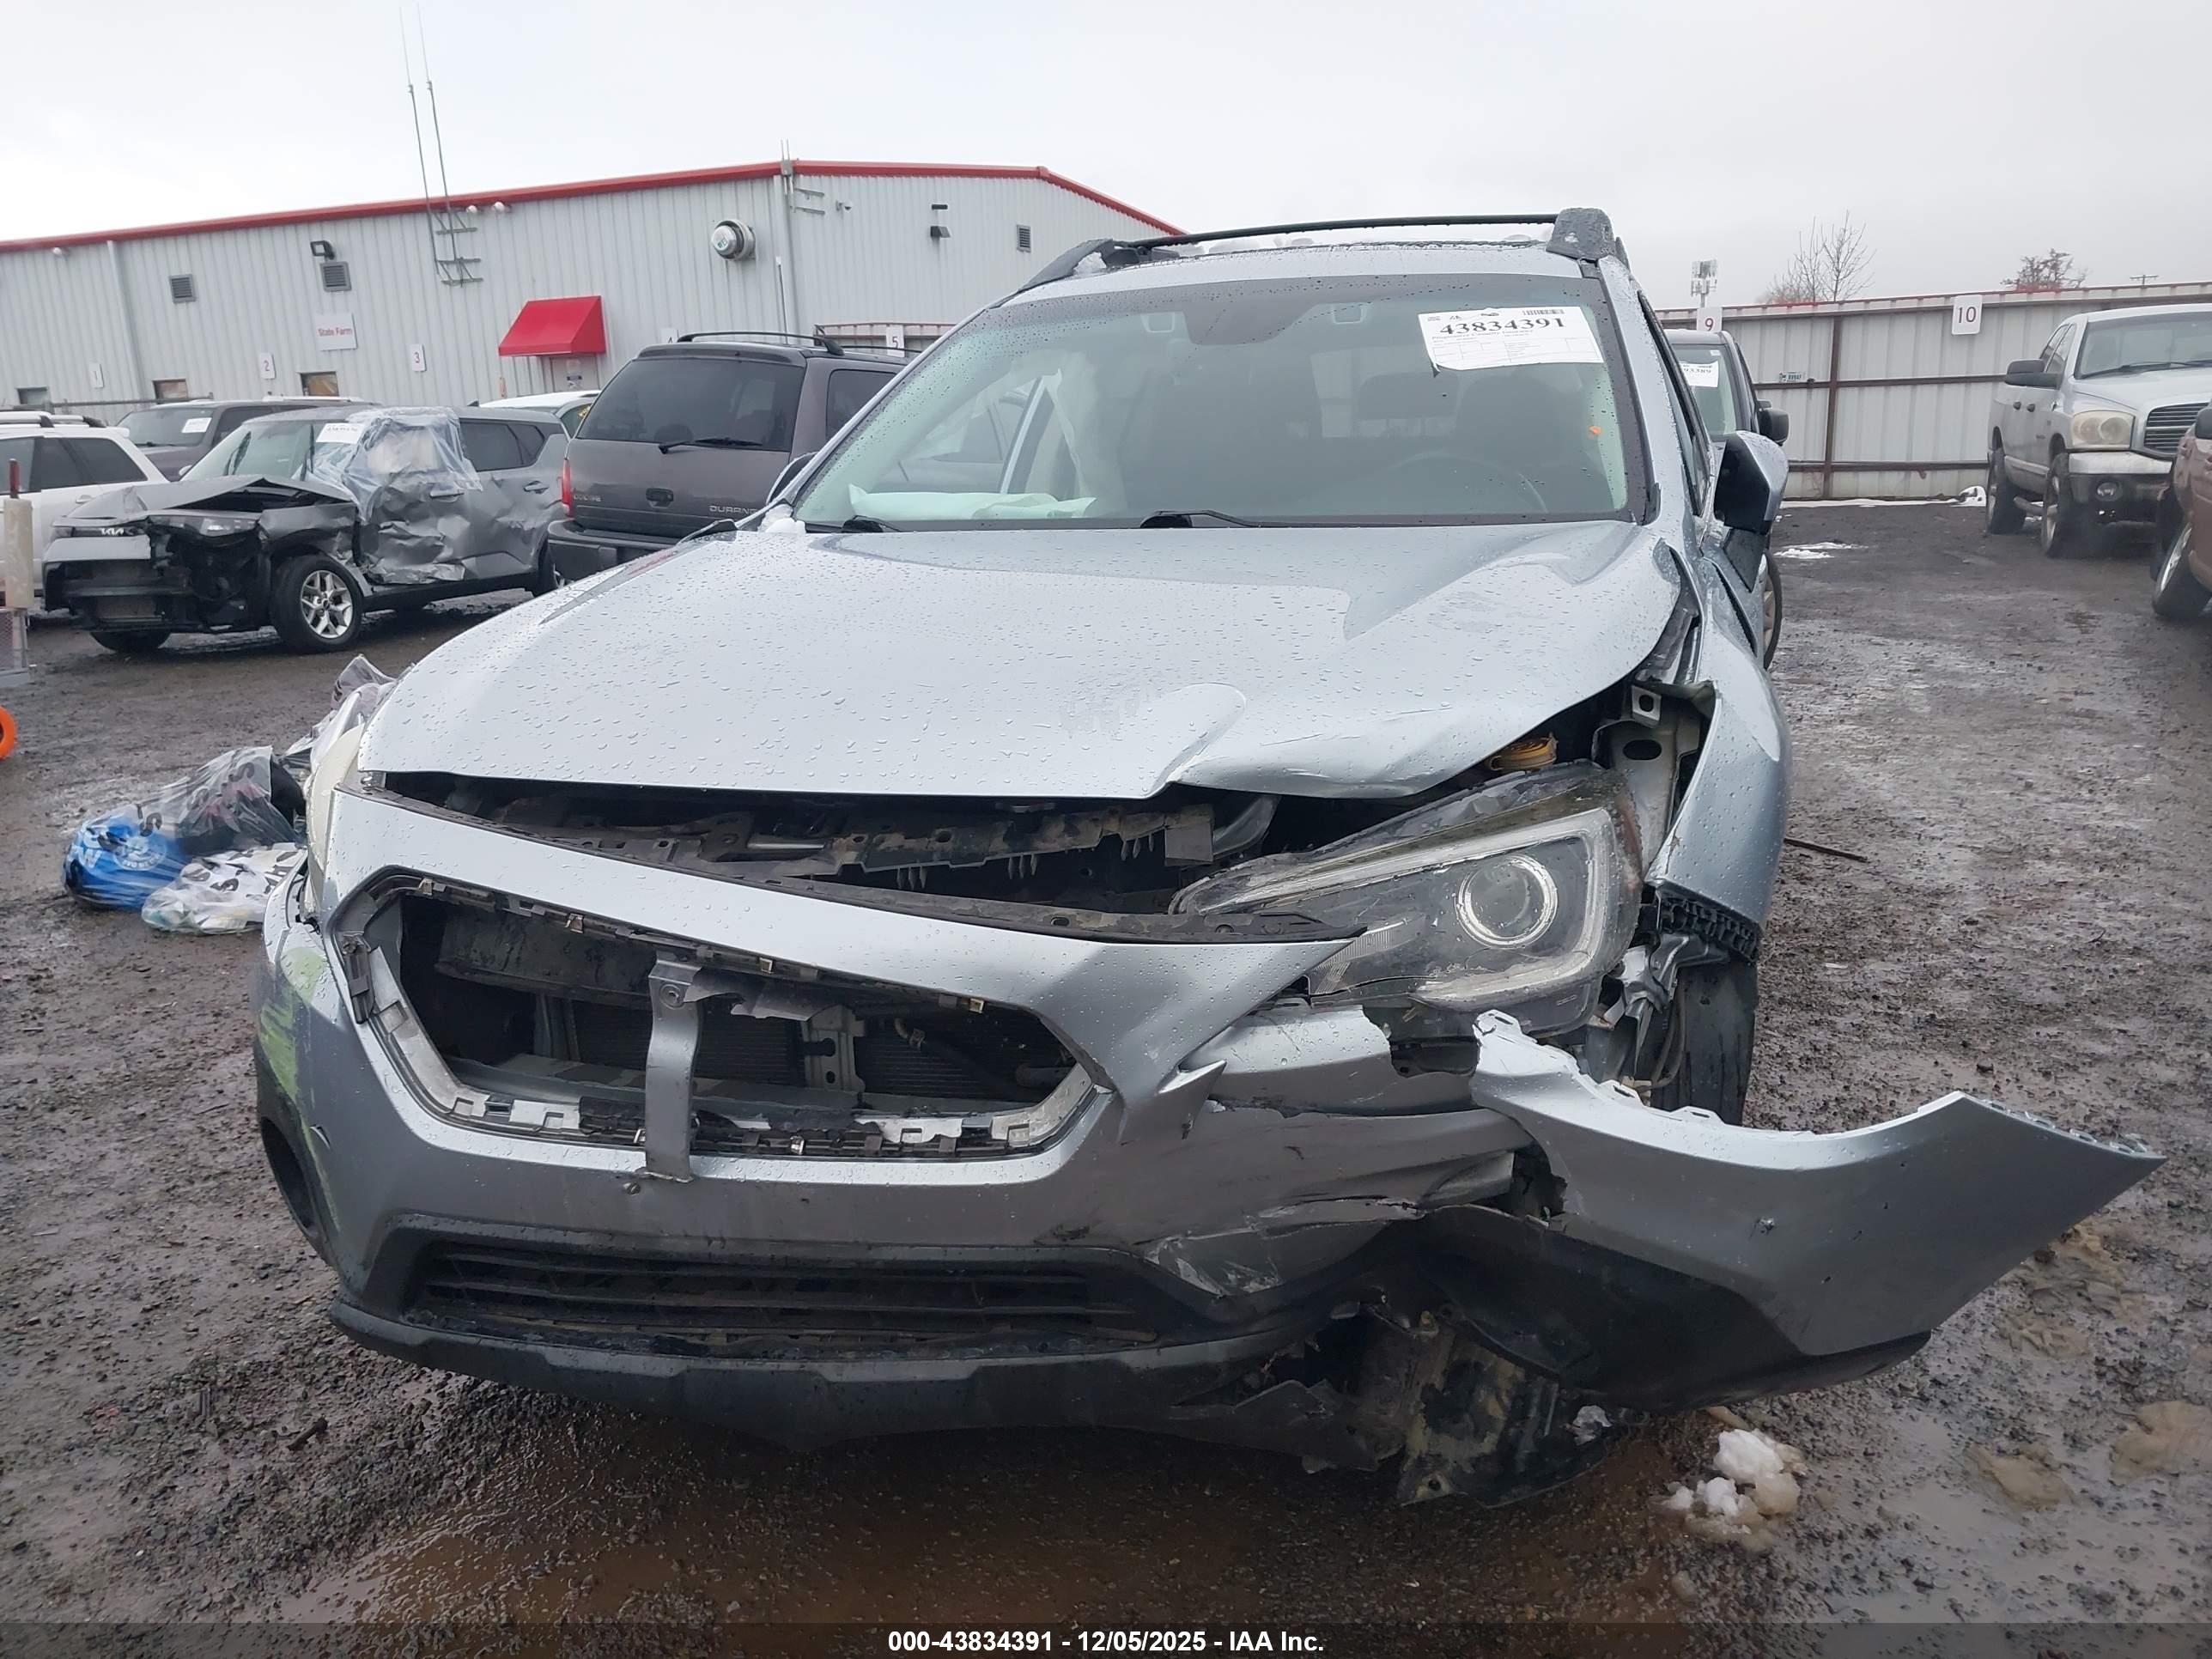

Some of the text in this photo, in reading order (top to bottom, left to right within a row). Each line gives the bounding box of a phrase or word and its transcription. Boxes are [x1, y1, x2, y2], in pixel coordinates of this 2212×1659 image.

[1959, 307, 1977, 323] 10
[1440, 318, 1565, 335] 43834391
[1705, 318, 1714, 331] 9
[318, 327, 335, 337] State
[892, 336, 899, 349] 5
[414, 351, 421, 363] 3
[264, 360, 270, 371] 2
[708, 505, 758, 515] DURANG
